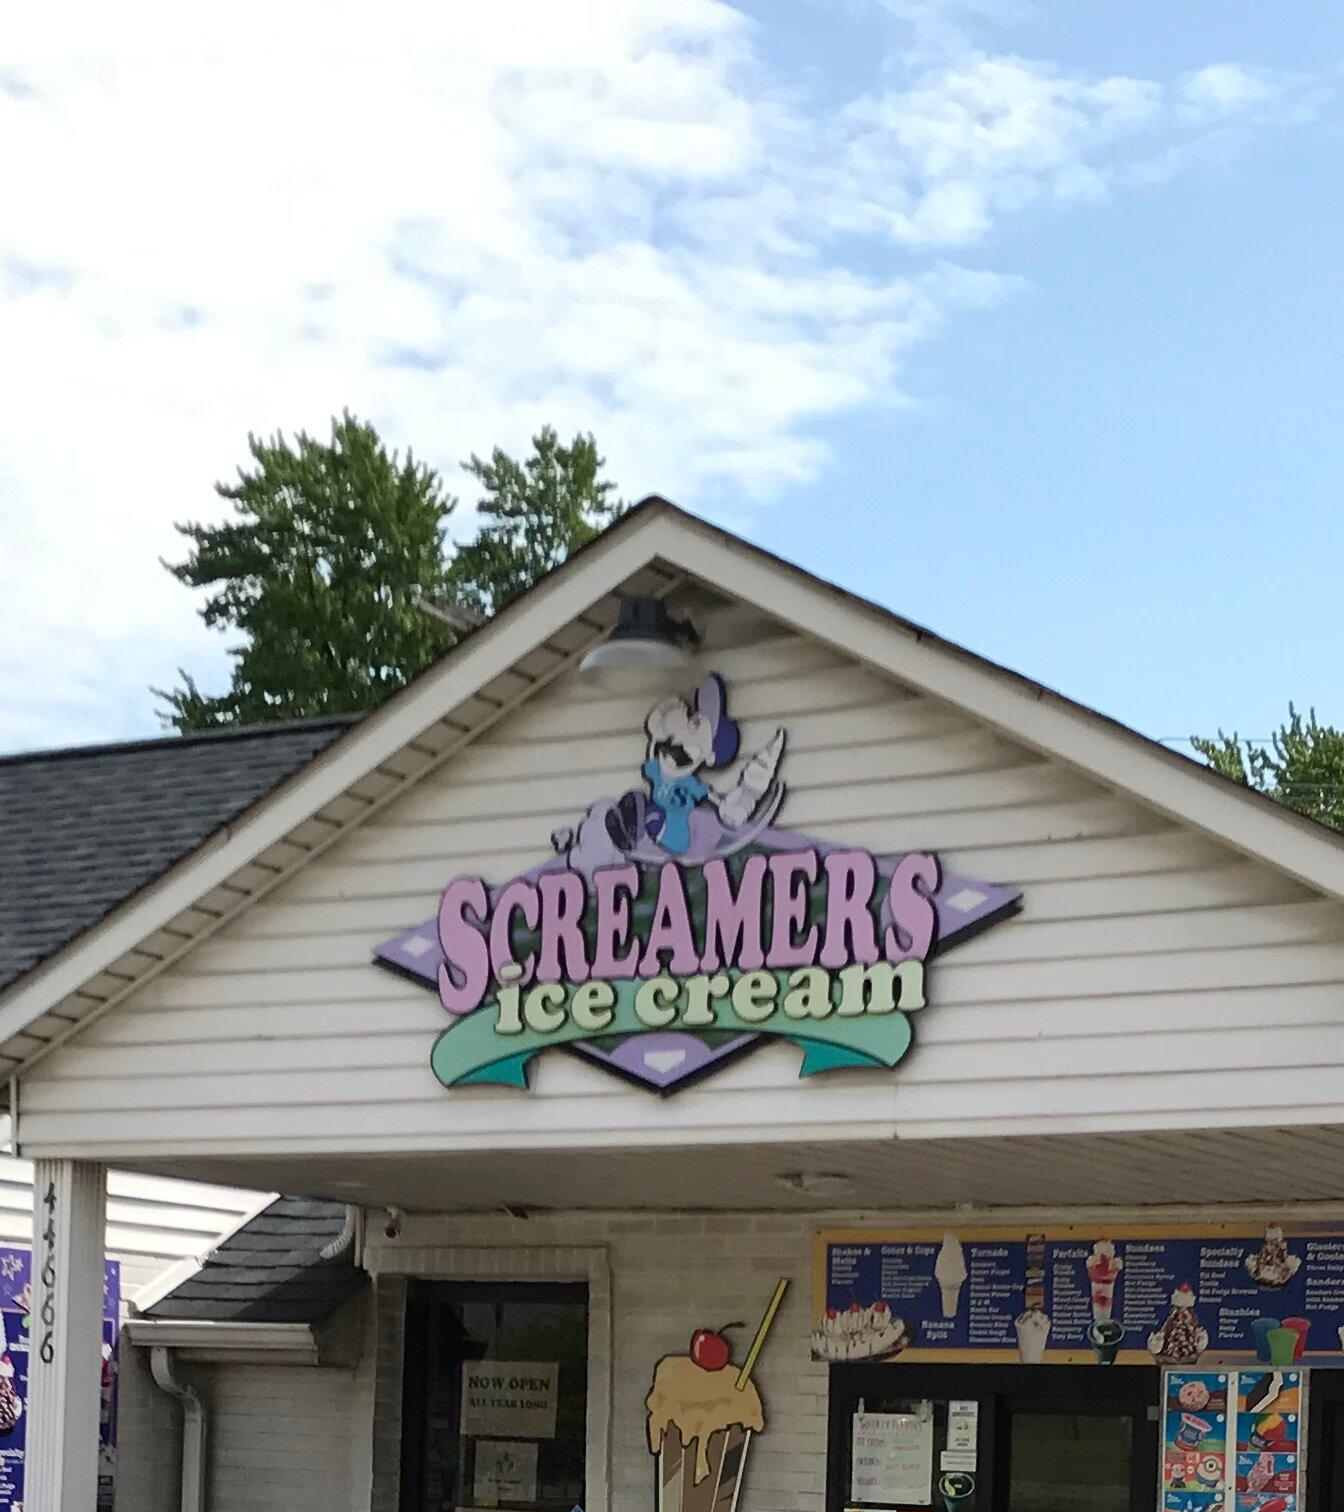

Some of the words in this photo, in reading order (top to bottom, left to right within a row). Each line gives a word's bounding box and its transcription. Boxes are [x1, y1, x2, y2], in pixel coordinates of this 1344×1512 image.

[437, 848, 941, 1014] SCREAMERS
[493, 963, 616, 1036] ice
[634, 959, 927, 1027] cream
[971, 1248, 1008, 1258] Tornado
[1200, 1247, 1244, 1259] Specialty
[927, 1330, 948, 1341] Split
[468, 1376, 505, 1390] NOW
[509, 1377, 550, 1391] OPEN
